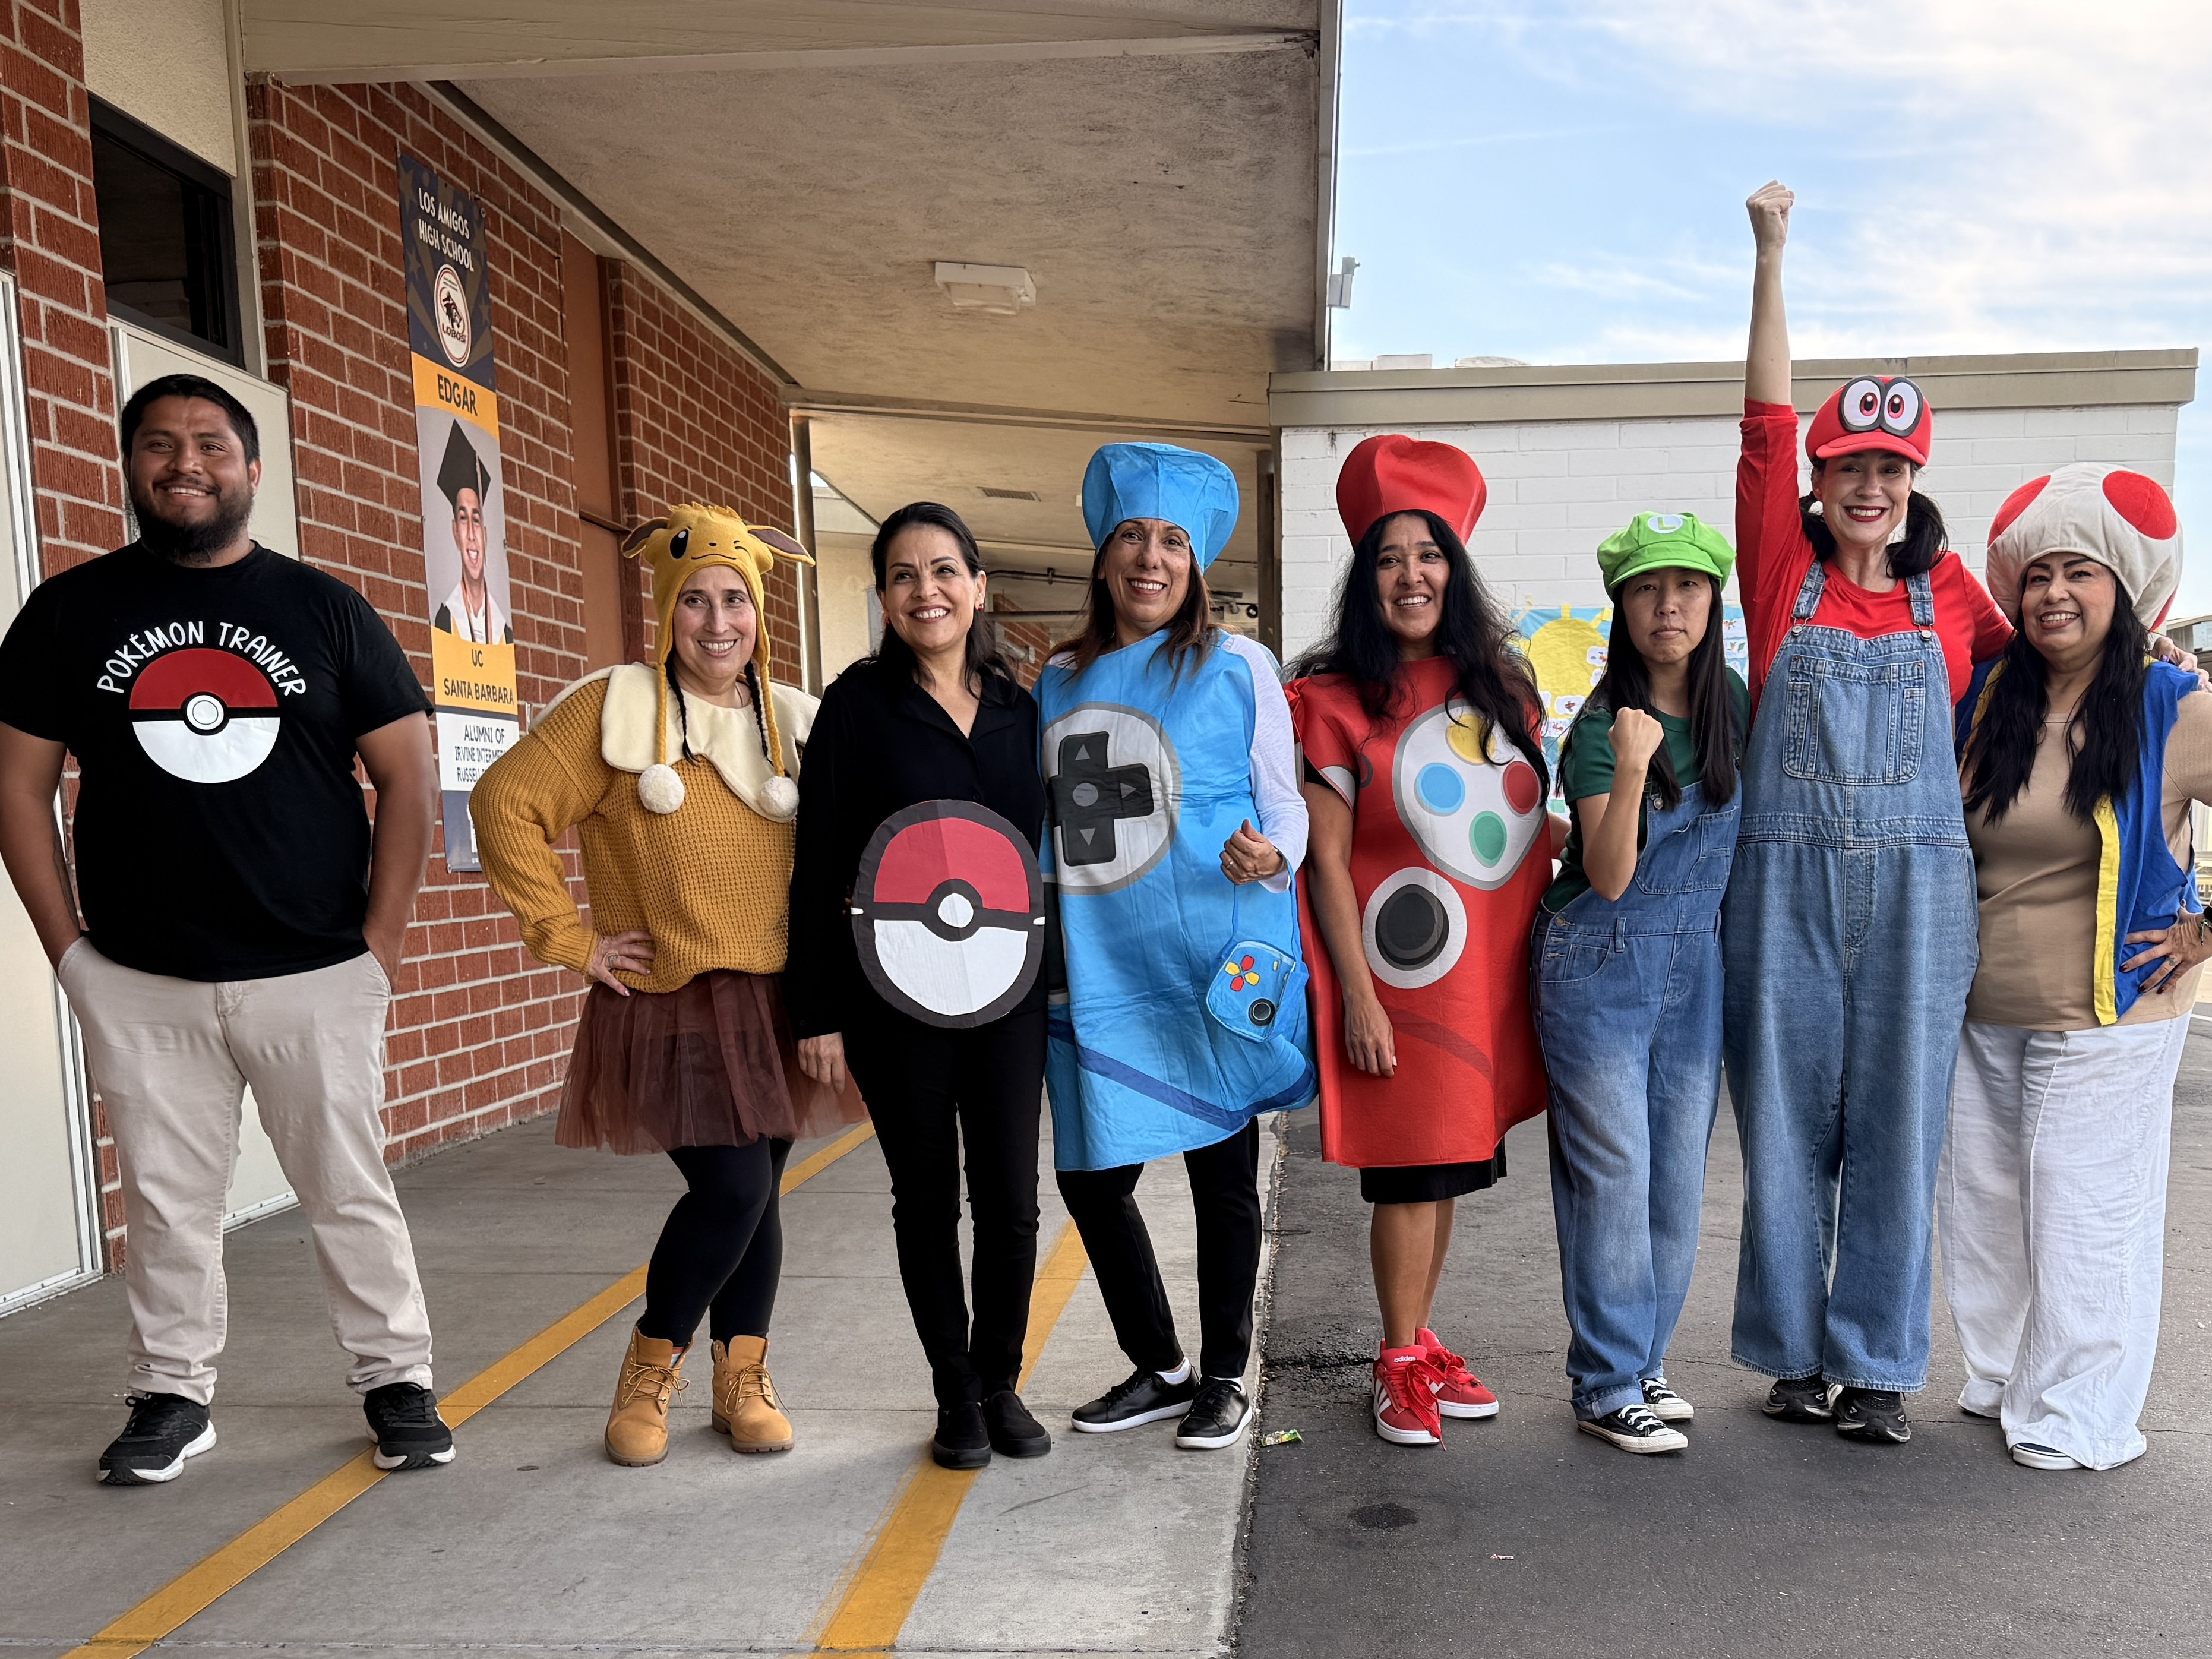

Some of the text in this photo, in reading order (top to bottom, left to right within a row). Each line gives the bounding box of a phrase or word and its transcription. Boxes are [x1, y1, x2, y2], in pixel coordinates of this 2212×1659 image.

[419, 188, 470, 239] LOS AMIGOS
[418, 219, 474, 272] HIGH SCHOOL
[442, 323, 466, 343] LOBOS
[437, 374, 478, 416] EDGAR
[1657, 516, 1677, 530] L
[97, 621, 306, 696] POKÉMON TRAINER
[472, 649, 484, 668] UC
[444, 678, 514, 706] SANTA BARBARA
[464, 724, 504, 744] ALUMNI OF
[455, 745, 506, 763] IRVINE INTERME
